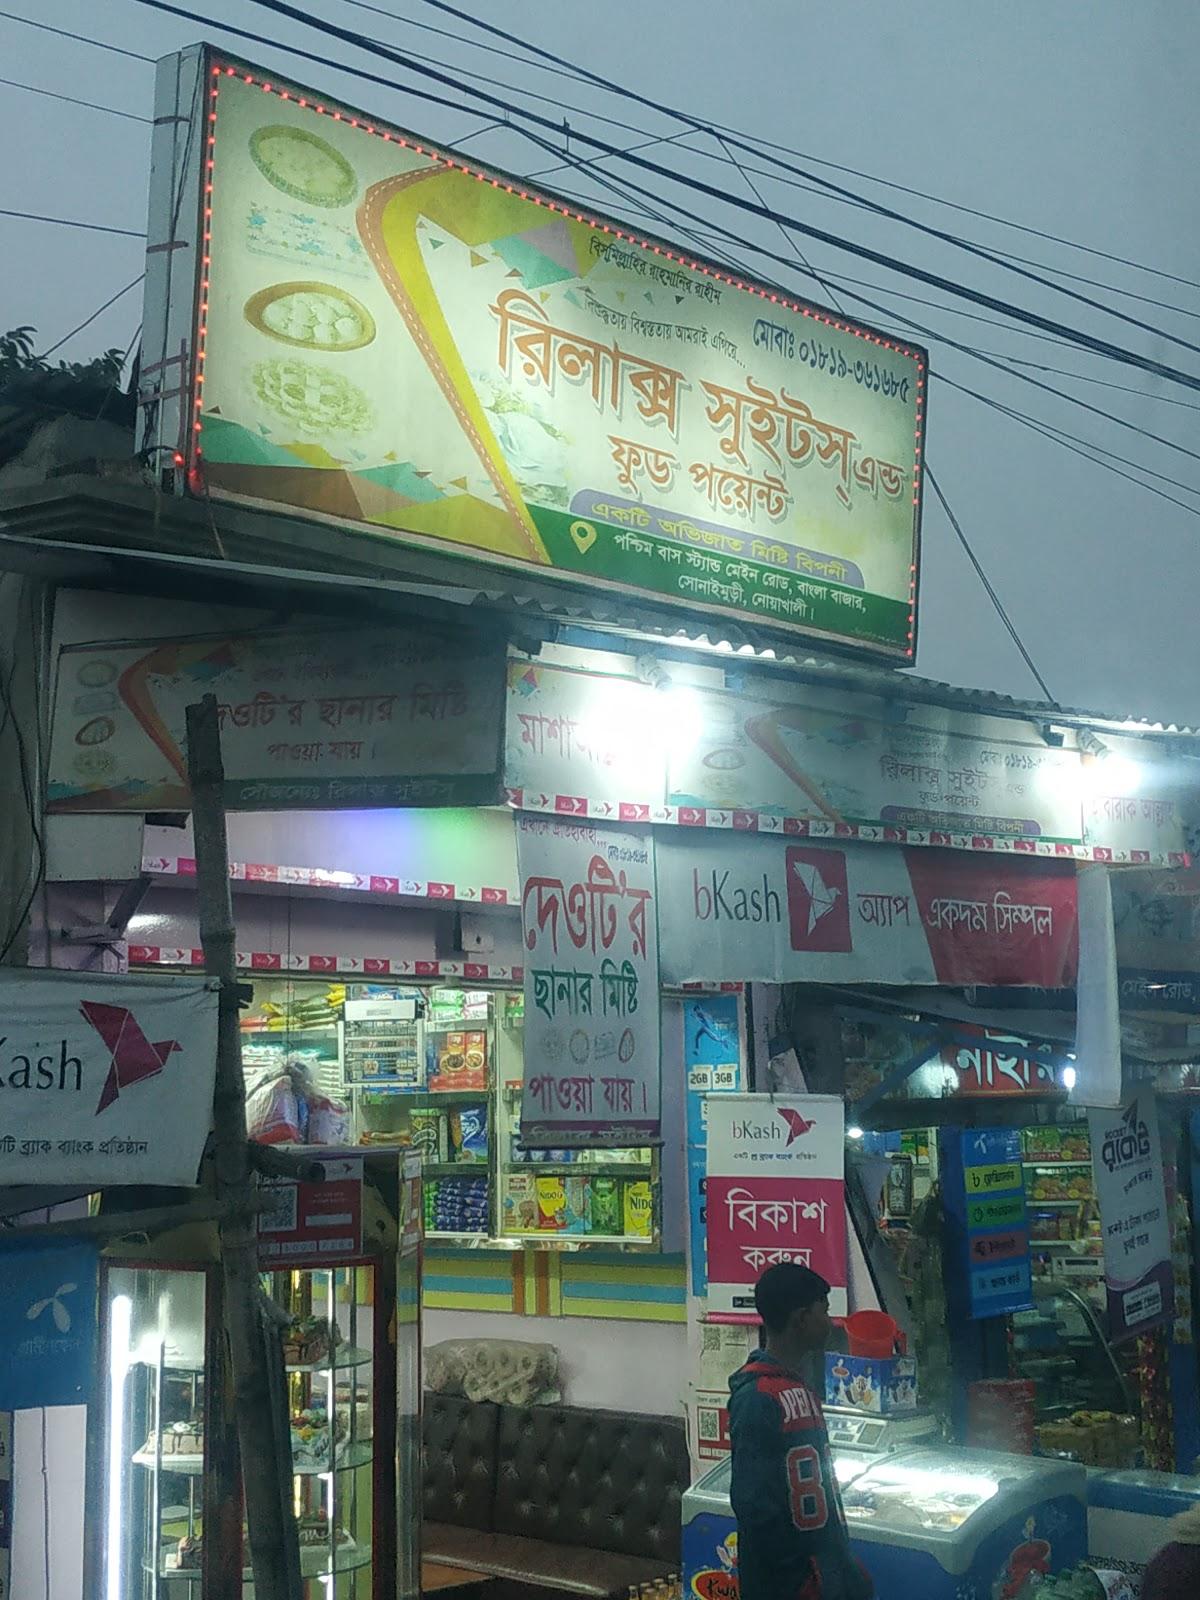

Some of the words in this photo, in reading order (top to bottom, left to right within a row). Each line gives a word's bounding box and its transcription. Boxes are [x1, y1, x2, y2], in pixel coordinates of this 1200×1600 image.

[489, 288, 688, 434] রিলাক্স
[853, 457, 904, 497] এন্ড
[608, 434, 677, 493] ফুড
[688, 463, 788, 517] পয়েন্ট
[591, 501, 651, 528] একটি
[657, 517, 745, 553] অভিজাত
[751, 540, 789, 566] মিষ্টি
[613, 533, 652, 559] পশ্চিম
[657, 545, 681, 566] বাস
[725, 561, 758, 584] মেইন
[761, 570, 793, 595] রোড,
[797, 581, 828, 602] বাংলা
[830, 588, 868, 614] বাজার,
[692, 867, 782, 924] bKash
[856, 893, 912, 927] অ্যাপ
[927, 897, 988, 934] একদম
[992, 890, 1053, 937] সিম্পল
[531, 962, 595, 1021] ছানার
[598, 957, 640, 1017] মিষ্টি
[529, 1072, 595, 1114] পাওয়া
[689, 1072, 709, 1085] 2GB
[714, 1072, 733, 1085] 3GB
[19, 1137, 53, 1157] ব্র্যাক
[57, 1138, 95, 1156] ব্যাংক
[732, 1119, 782, 1141] bKash
[724, 1187, 831, 1235] বিকাশ
